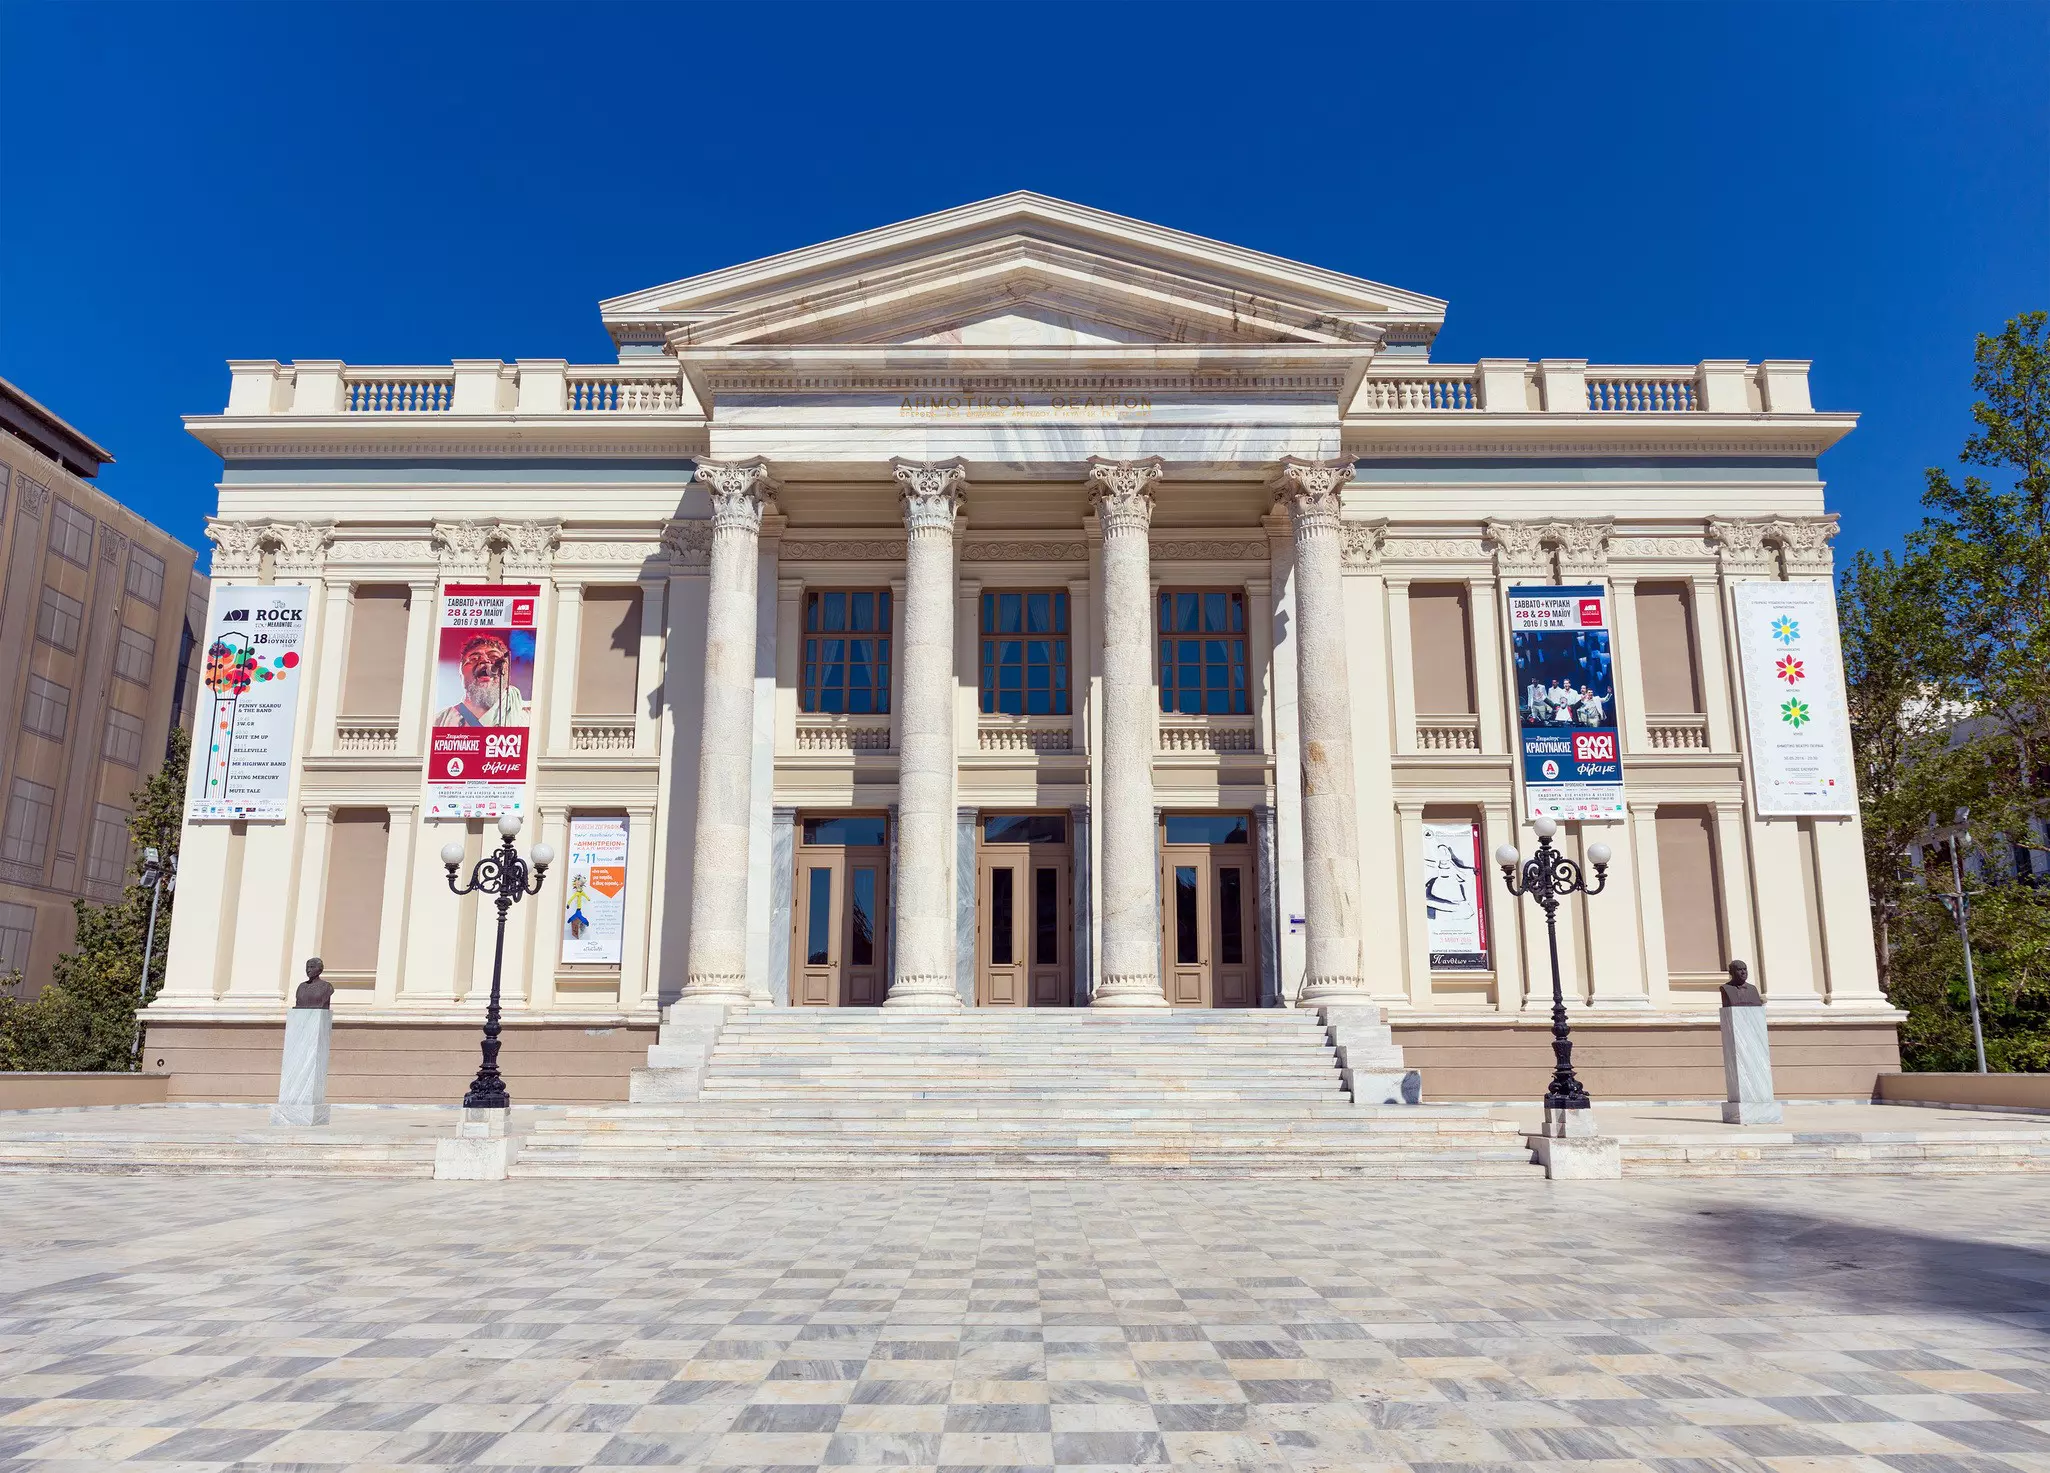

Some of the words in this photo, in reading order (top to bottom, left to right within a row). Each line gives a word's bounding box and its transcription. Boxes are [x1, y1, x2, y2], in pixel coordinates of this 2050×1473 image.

[900, 394, 1026, 410] ΔΗΜΟΤΙΚΟΝ
[1052, 394, 1152, 410] ΘΕΑΤΡΟΝ
[256, 610, 303, 620] ROCK
[484, 607, 503, 616] ΜΑΪΟΥ
[253, 634, 268, 644] 18
[434, 740, 480, 751] ΚΡΑΟΥΝΑΚΗΣ
[485, 734, 522, 746] ΟΛΟΙ
[1576, 736, 1612, 748] ΟΛΟΙ
[485, 746, 521, 757] ΕΝΑ!
[1526, 742, 1572, 753] ΚΡΑΟΥΝΑΚΗΣ
[1578, 747, 1613, 759] ΕΝΑ!
[573, 853, 579, 863] 7
[586, 853, 596, 863] 11
